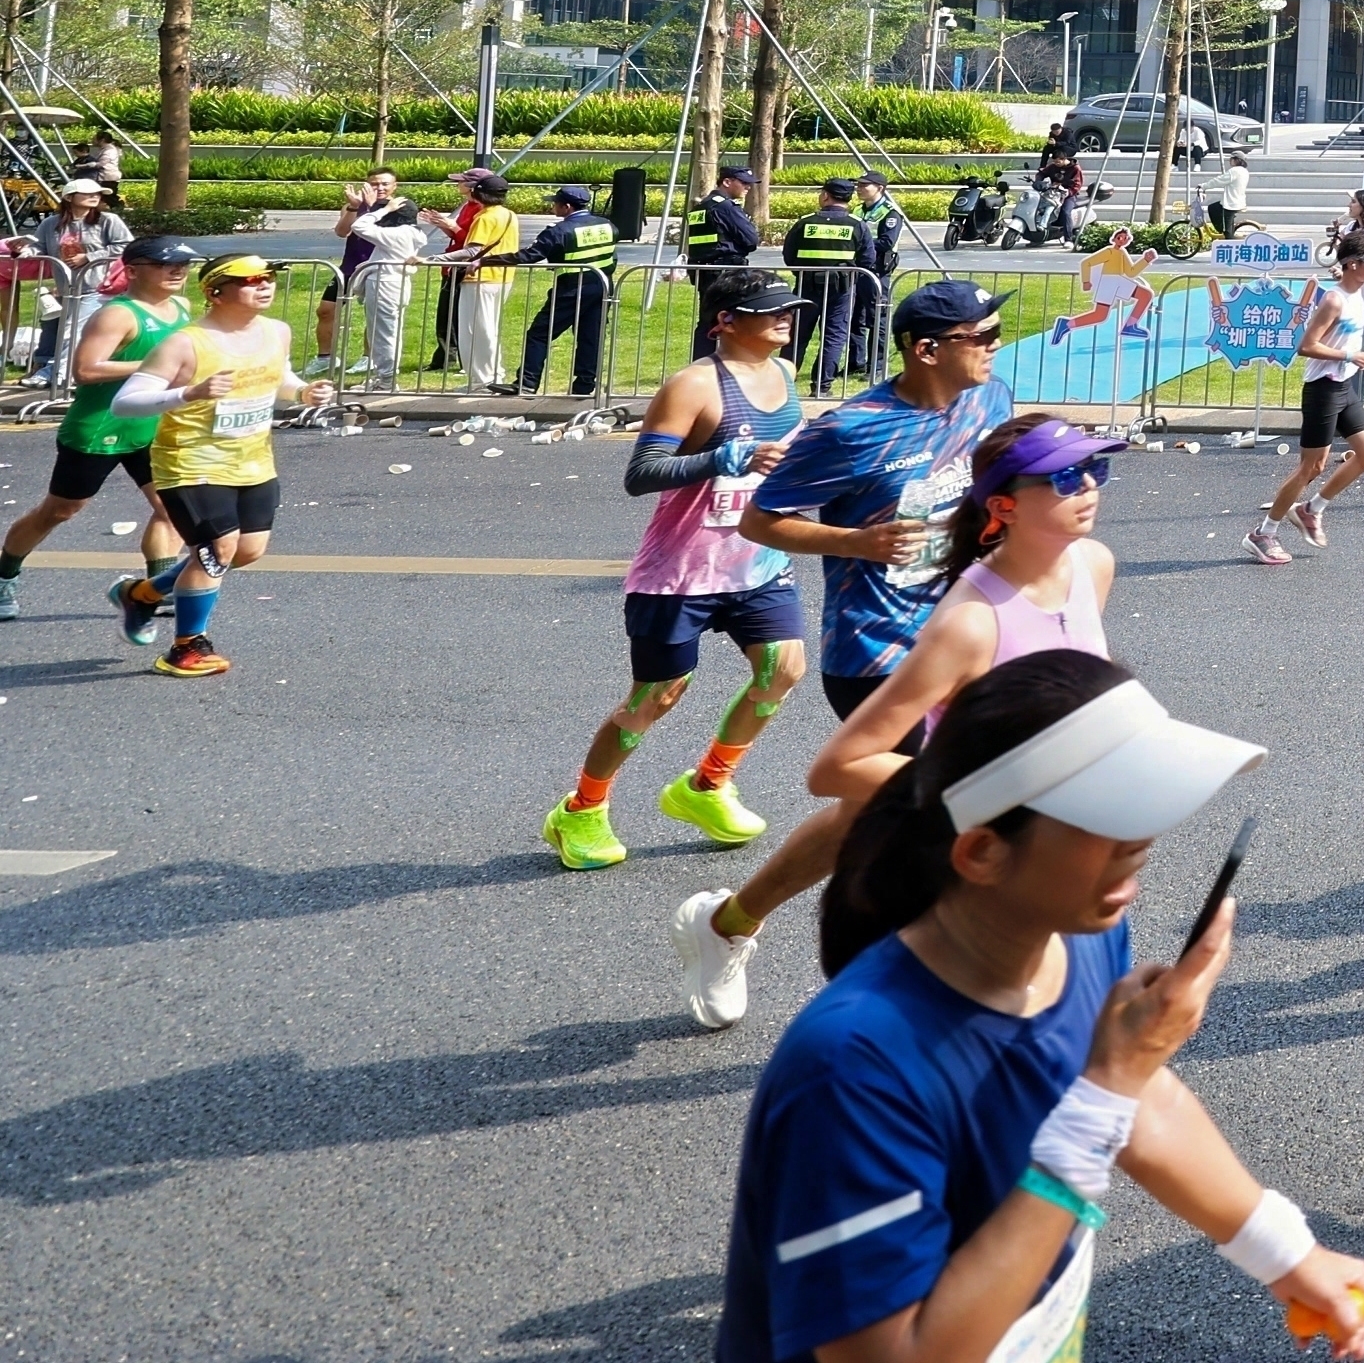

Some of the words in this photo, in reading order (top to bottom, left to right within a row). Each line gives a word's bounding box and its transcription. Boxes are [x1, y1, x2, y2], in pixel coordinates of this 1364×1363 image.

[1216, 244, 1309, 263] 前海加油站
[1243, 305, 1281, 326] 给你
[233, 375, 279, 390] ARATHON
[885, 451, 934, 473] HONOR
